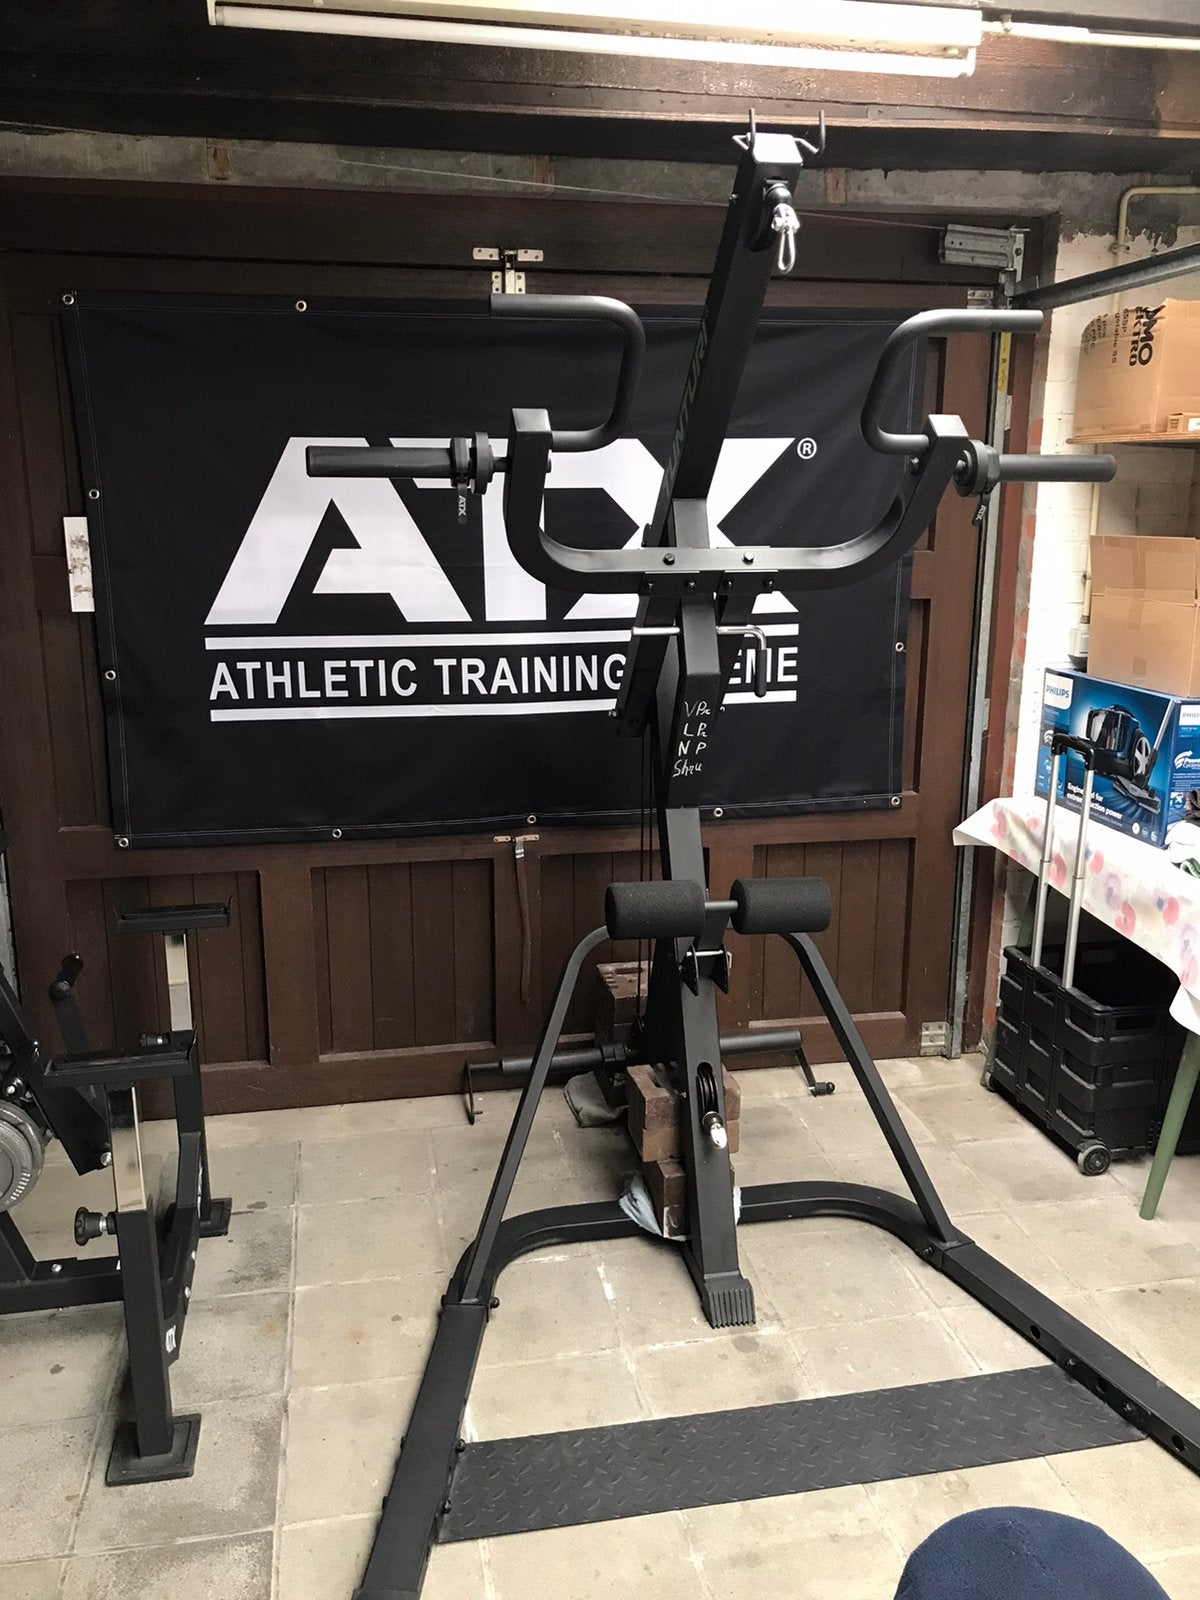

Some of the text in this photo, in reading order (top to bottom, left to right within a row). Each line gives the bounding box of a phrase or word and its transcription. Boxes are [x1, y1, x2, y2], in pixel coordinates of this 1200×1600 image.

[458, 495, 467, 516] ATX
[209, 653, 627, 701] ATHLETIC TRAINING
[1046, 684, 1070, 699] PHILIPS
